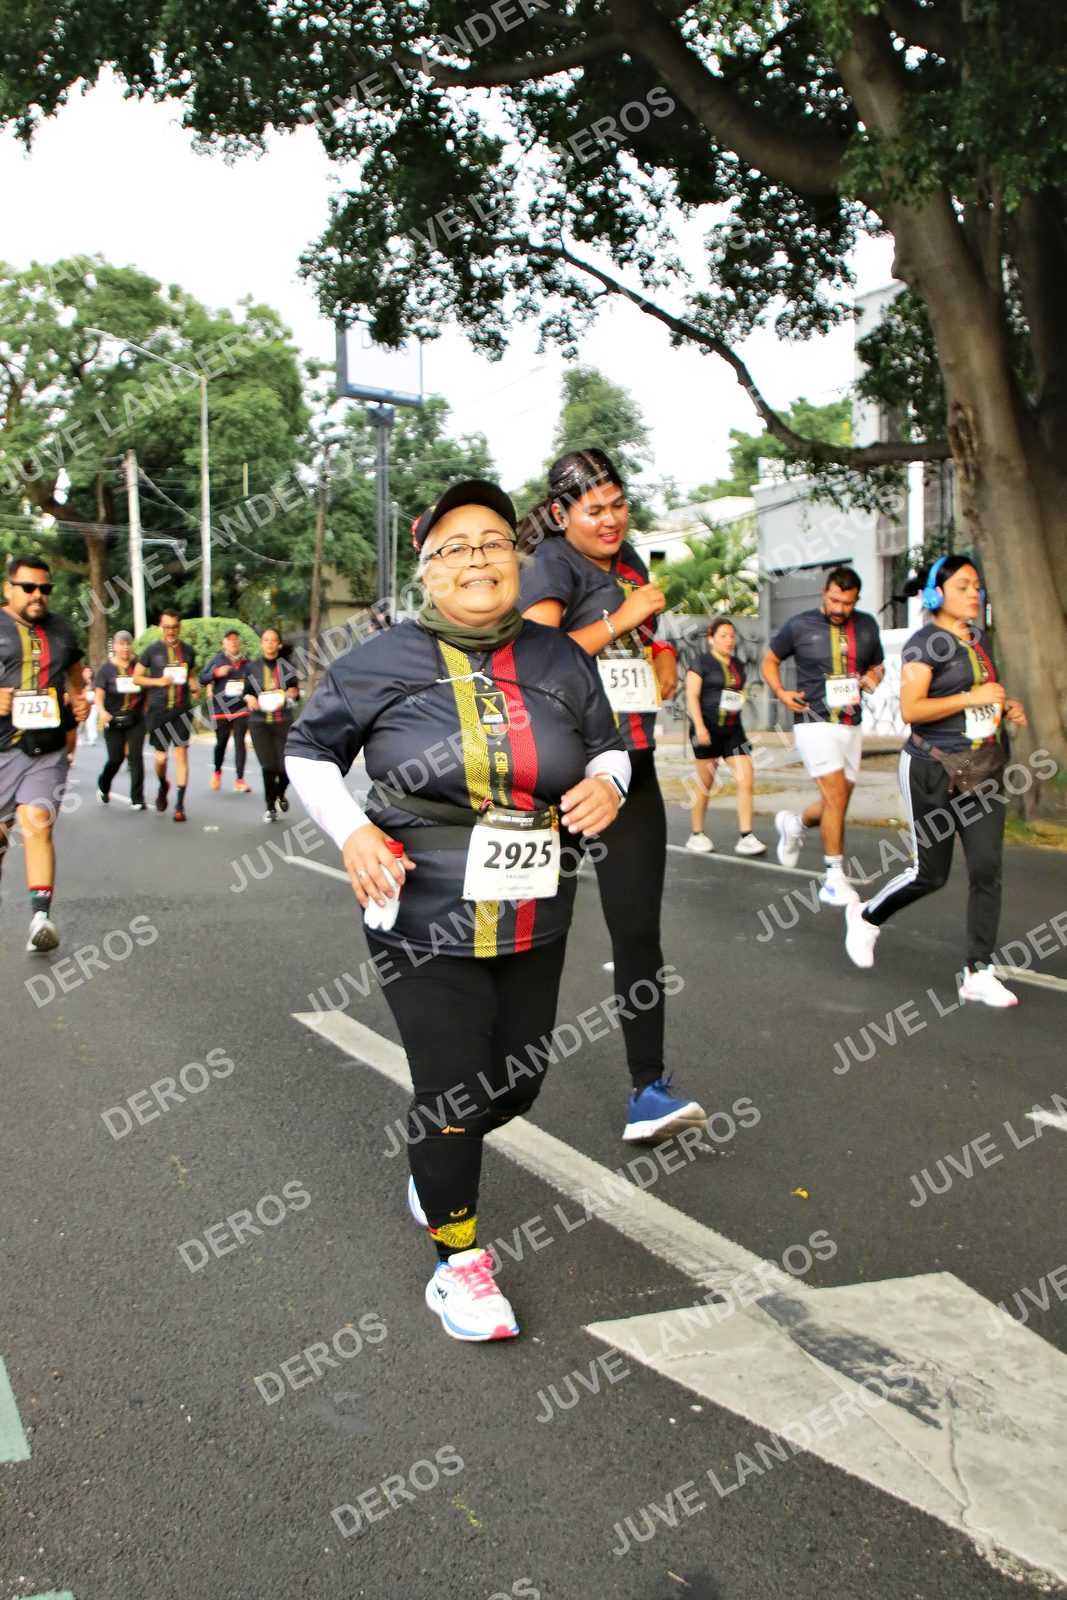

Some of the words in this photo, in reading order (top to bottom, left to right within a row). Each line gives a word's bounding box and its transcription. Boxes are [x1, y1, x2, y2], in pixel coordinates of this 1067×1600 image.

[610, 667, 647, 688] 5511
[20, 701, 49, 714] 7257
[483, 839, 552, 869] 2925
